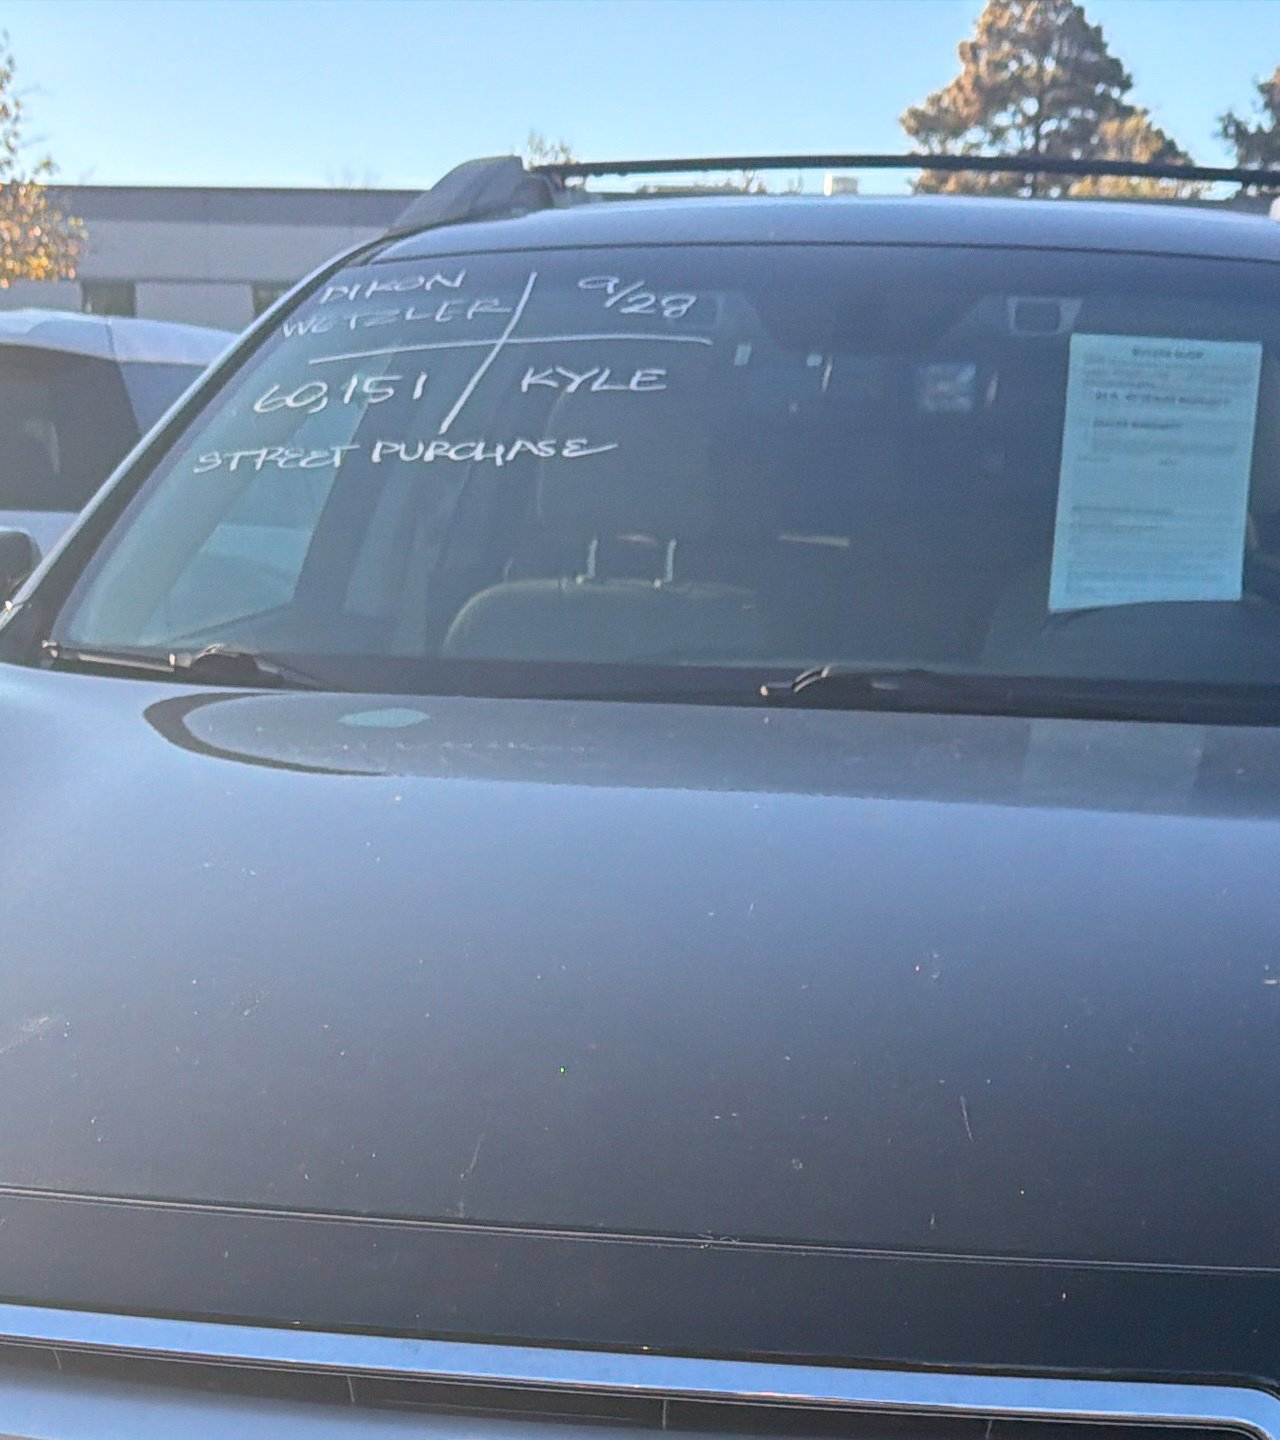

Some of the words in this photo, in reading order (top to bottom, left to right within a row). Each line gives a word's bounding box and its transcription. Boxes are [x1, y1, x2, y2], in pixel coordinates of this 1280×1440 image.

[577, 275, 698, 319] 9/28
[253, 371, 428, 414] 60,151
[521, 365, 668, 394] KYLE
[193, 444, 361, 474] STREET
[371, 438, 619, 467] PURCHASE
